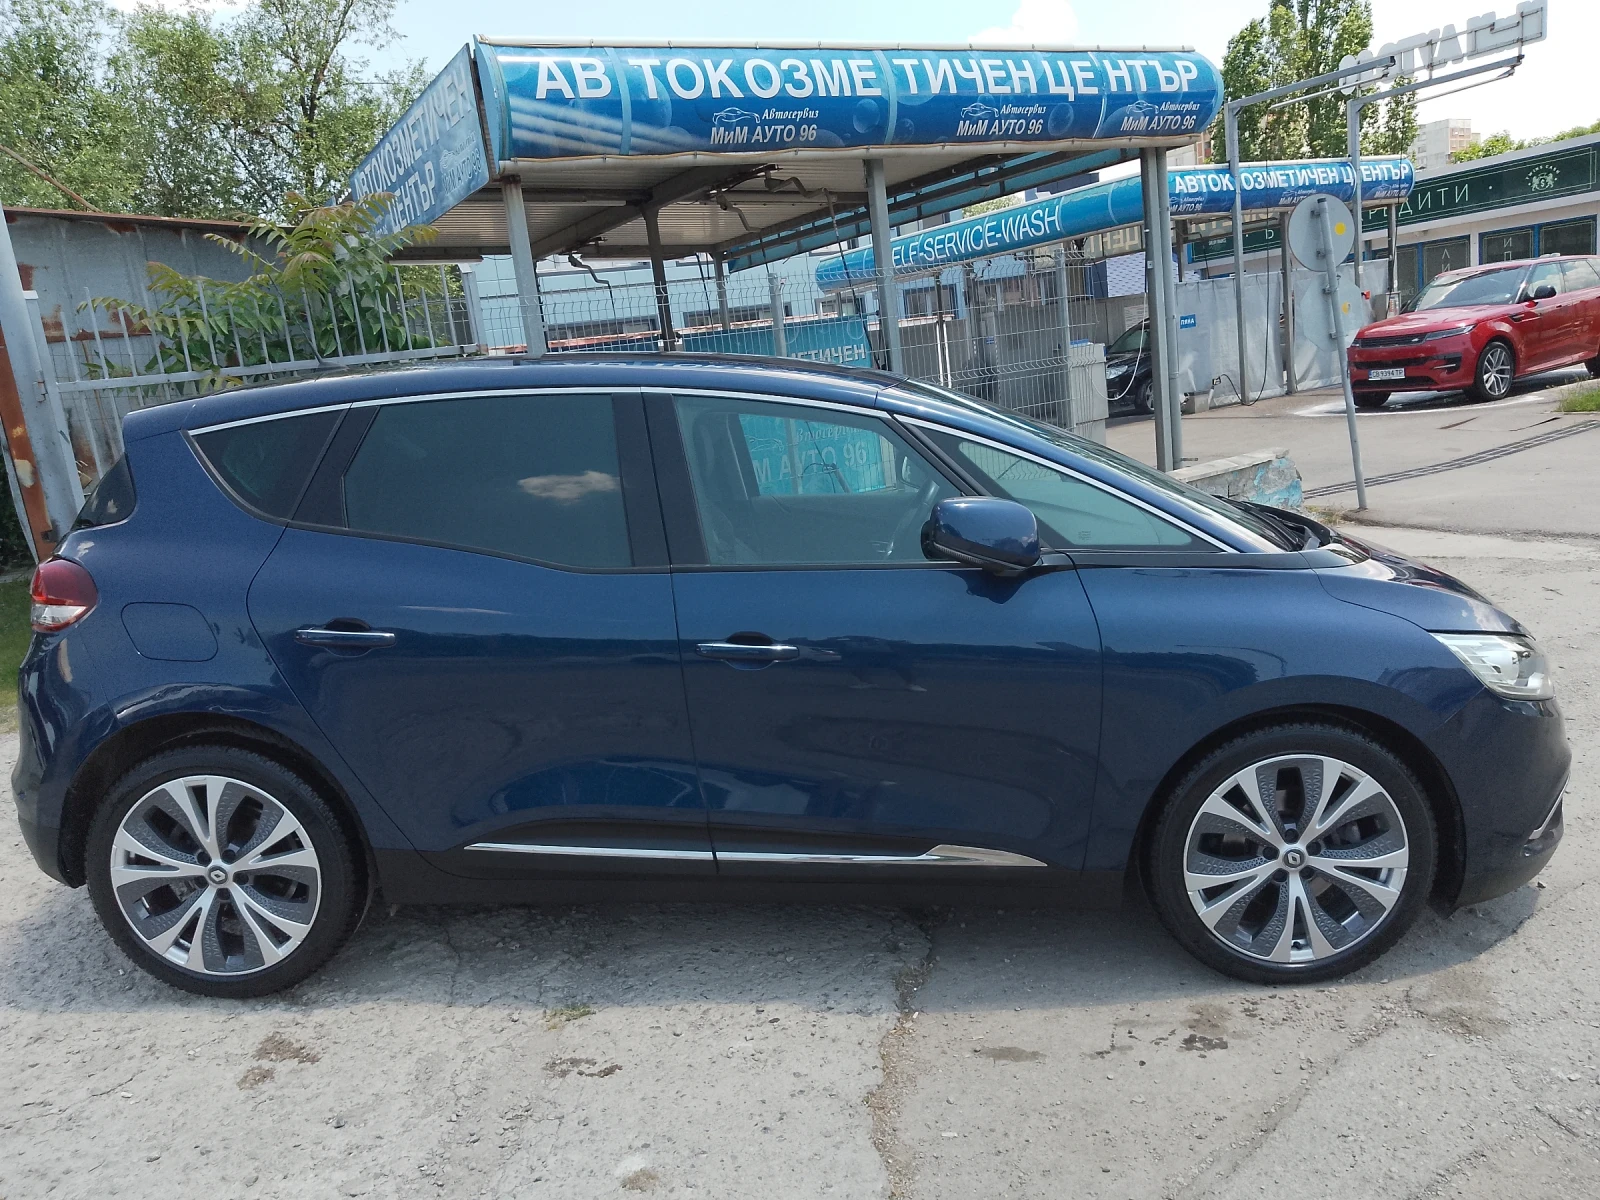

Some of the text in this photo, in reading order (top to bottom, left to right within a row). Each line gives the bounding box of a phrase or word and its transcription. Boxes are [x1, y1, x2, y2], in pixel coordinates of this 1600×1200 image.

[762, 107, 819, 122] Автосервиз
[1000, 104, 1046, 117] Автосервиз
[1160, 101, 1200, 113] Автосервиз
[956, 119, 1043, 136] МиМ АУТО 96
[1120, 115, 1196, 131] МиМ АУТО 96
[710, 124, 818, 145] МиМ АУТО 96
[891, 205, 1061, 267] ELF-SERVICE-WASH
[843, 441, 867, 467] 96
